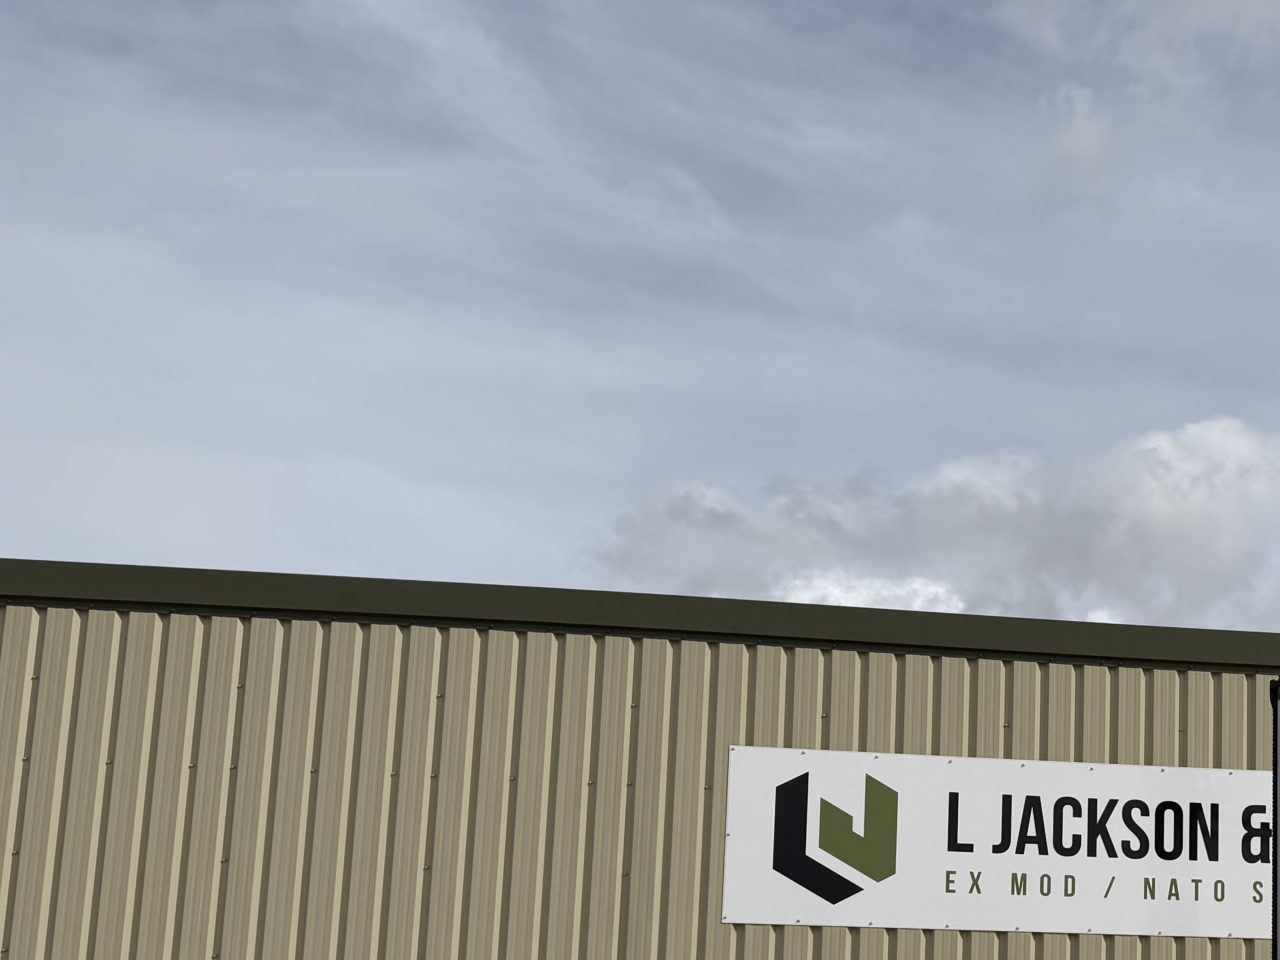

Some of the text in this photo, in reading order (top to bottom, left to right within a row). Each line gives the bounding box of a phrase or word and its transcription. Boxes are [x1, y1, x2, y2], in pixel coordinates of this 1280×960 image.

[947, 792, 974, 853] L
[992, 794, 1219, 863] JACKSON
[1240, 805, 1271, 864] &
[945, 870, 982, 895] EX
[1010, 873, 1076, 898] MOD
[1143, 878, 1225, 903] NATO
